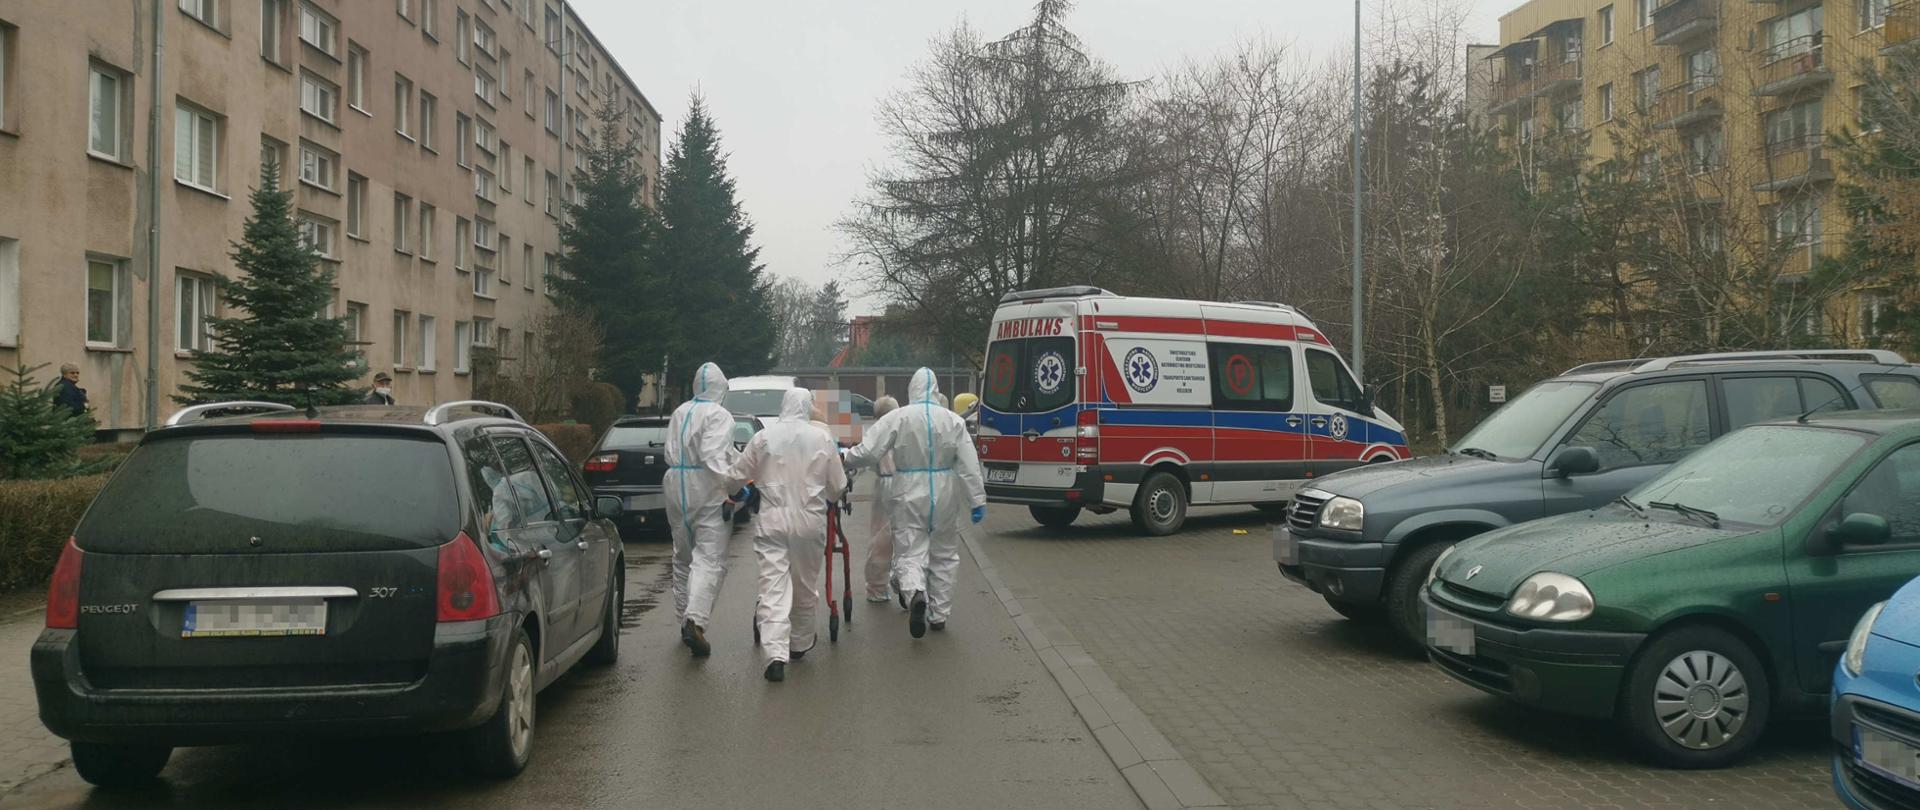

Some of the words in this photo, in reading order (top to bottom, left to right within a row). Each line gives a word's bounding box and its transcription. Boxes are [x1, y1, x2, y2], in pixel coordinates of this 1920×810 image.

[997, 317, 1063, 338] AMBULANS
[369, 587, 397, 598] 307
[81, 604, 138, 614] PEUGEOT
